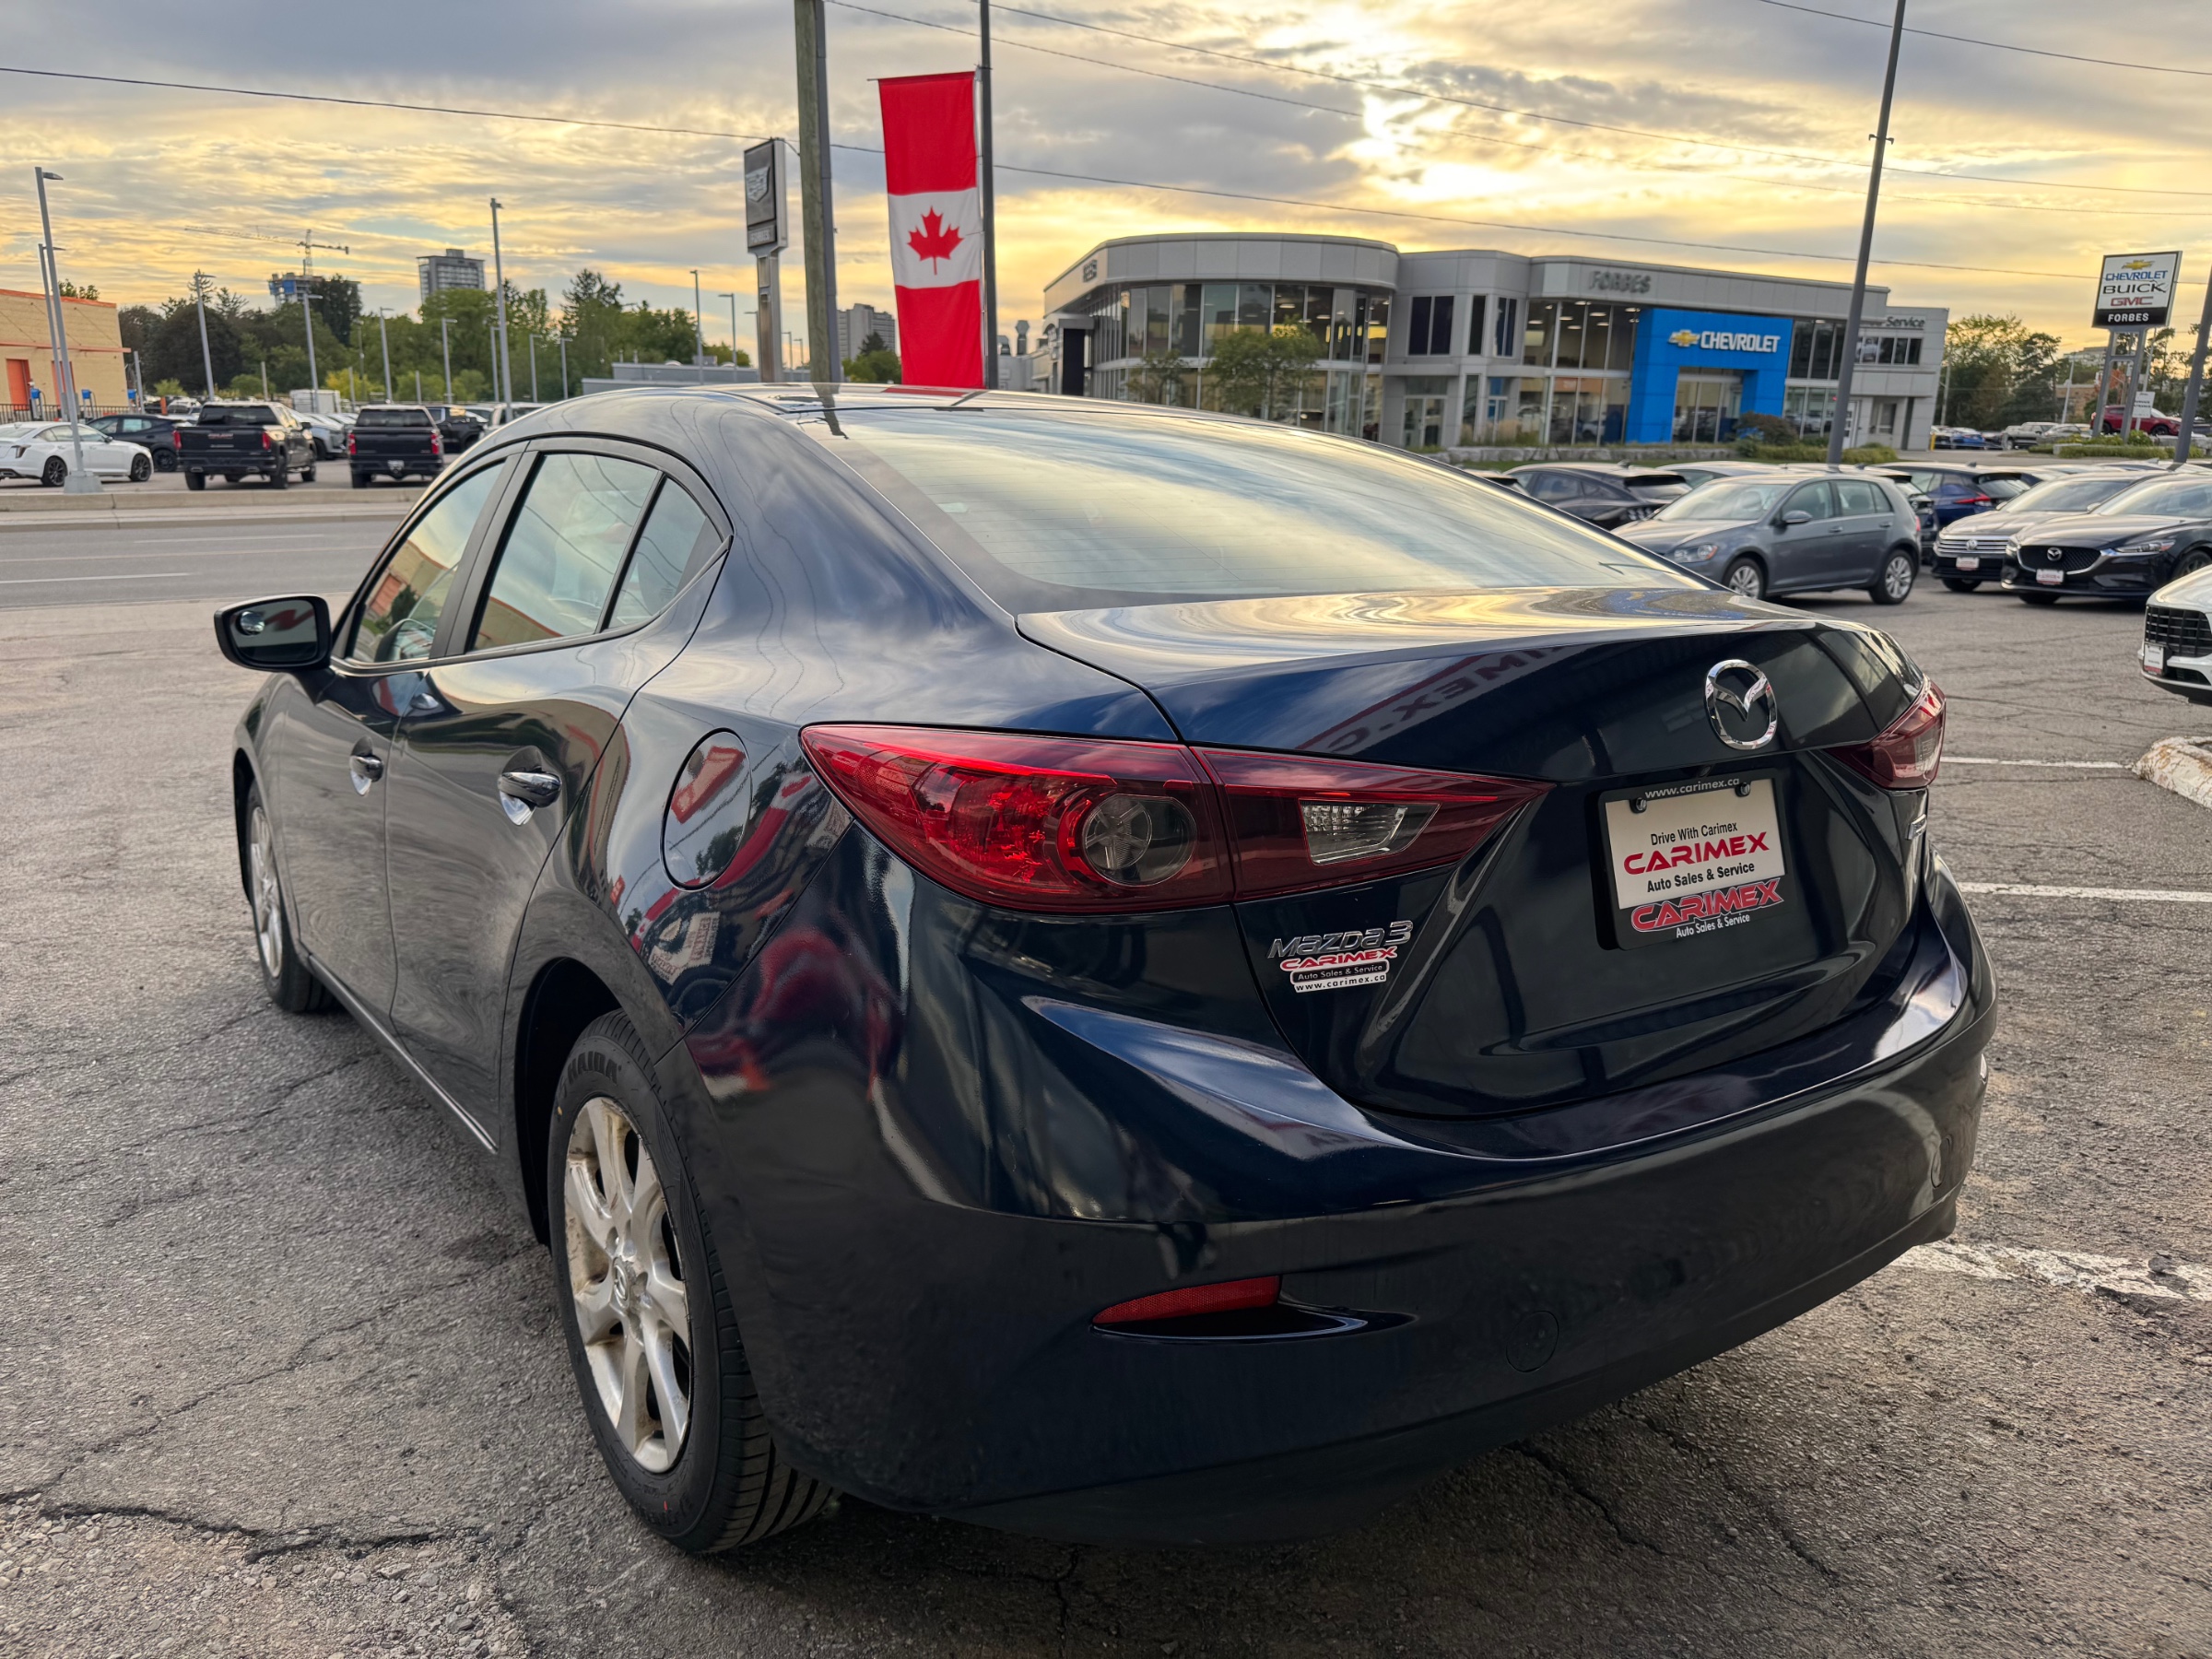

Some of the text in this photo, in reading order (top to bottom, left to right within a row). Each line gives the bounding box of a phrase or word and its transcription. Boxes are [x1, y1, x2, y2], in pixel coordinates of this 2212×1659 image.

[2105, 270, 2168, 281] CHEVROLET
[2102, 283, 2167, 294] BUICK
[2111, 296, 2154, 306] GMC
[1886, 316, 1925, 327] Service
[2108, 312, 2149, 323] FORBES
[1700, 331, 1781, 353] CHEVROLET
[1645, 778, 1740, 799] www.carimex.ca
[1651, 822, 1737, 845] Drive With Carimex
[1623, 831, 1770, 875] CARIMEX
[1647, 862, 1755, 892] Auto Sales & Service
[1631, 877, 1783, 932] CARIMEX
[1676, 913, 1750, 938] Auto Sales & Service
[1281, 947, 1397, 970] CARIMEX
[1296, 974, 1385, 992] www.carimex.ca
[1298, 972, 1318, 981] Auto
[1321, 969, 1343, 978] Sales
[1354, 964, 1382, 974] Service
